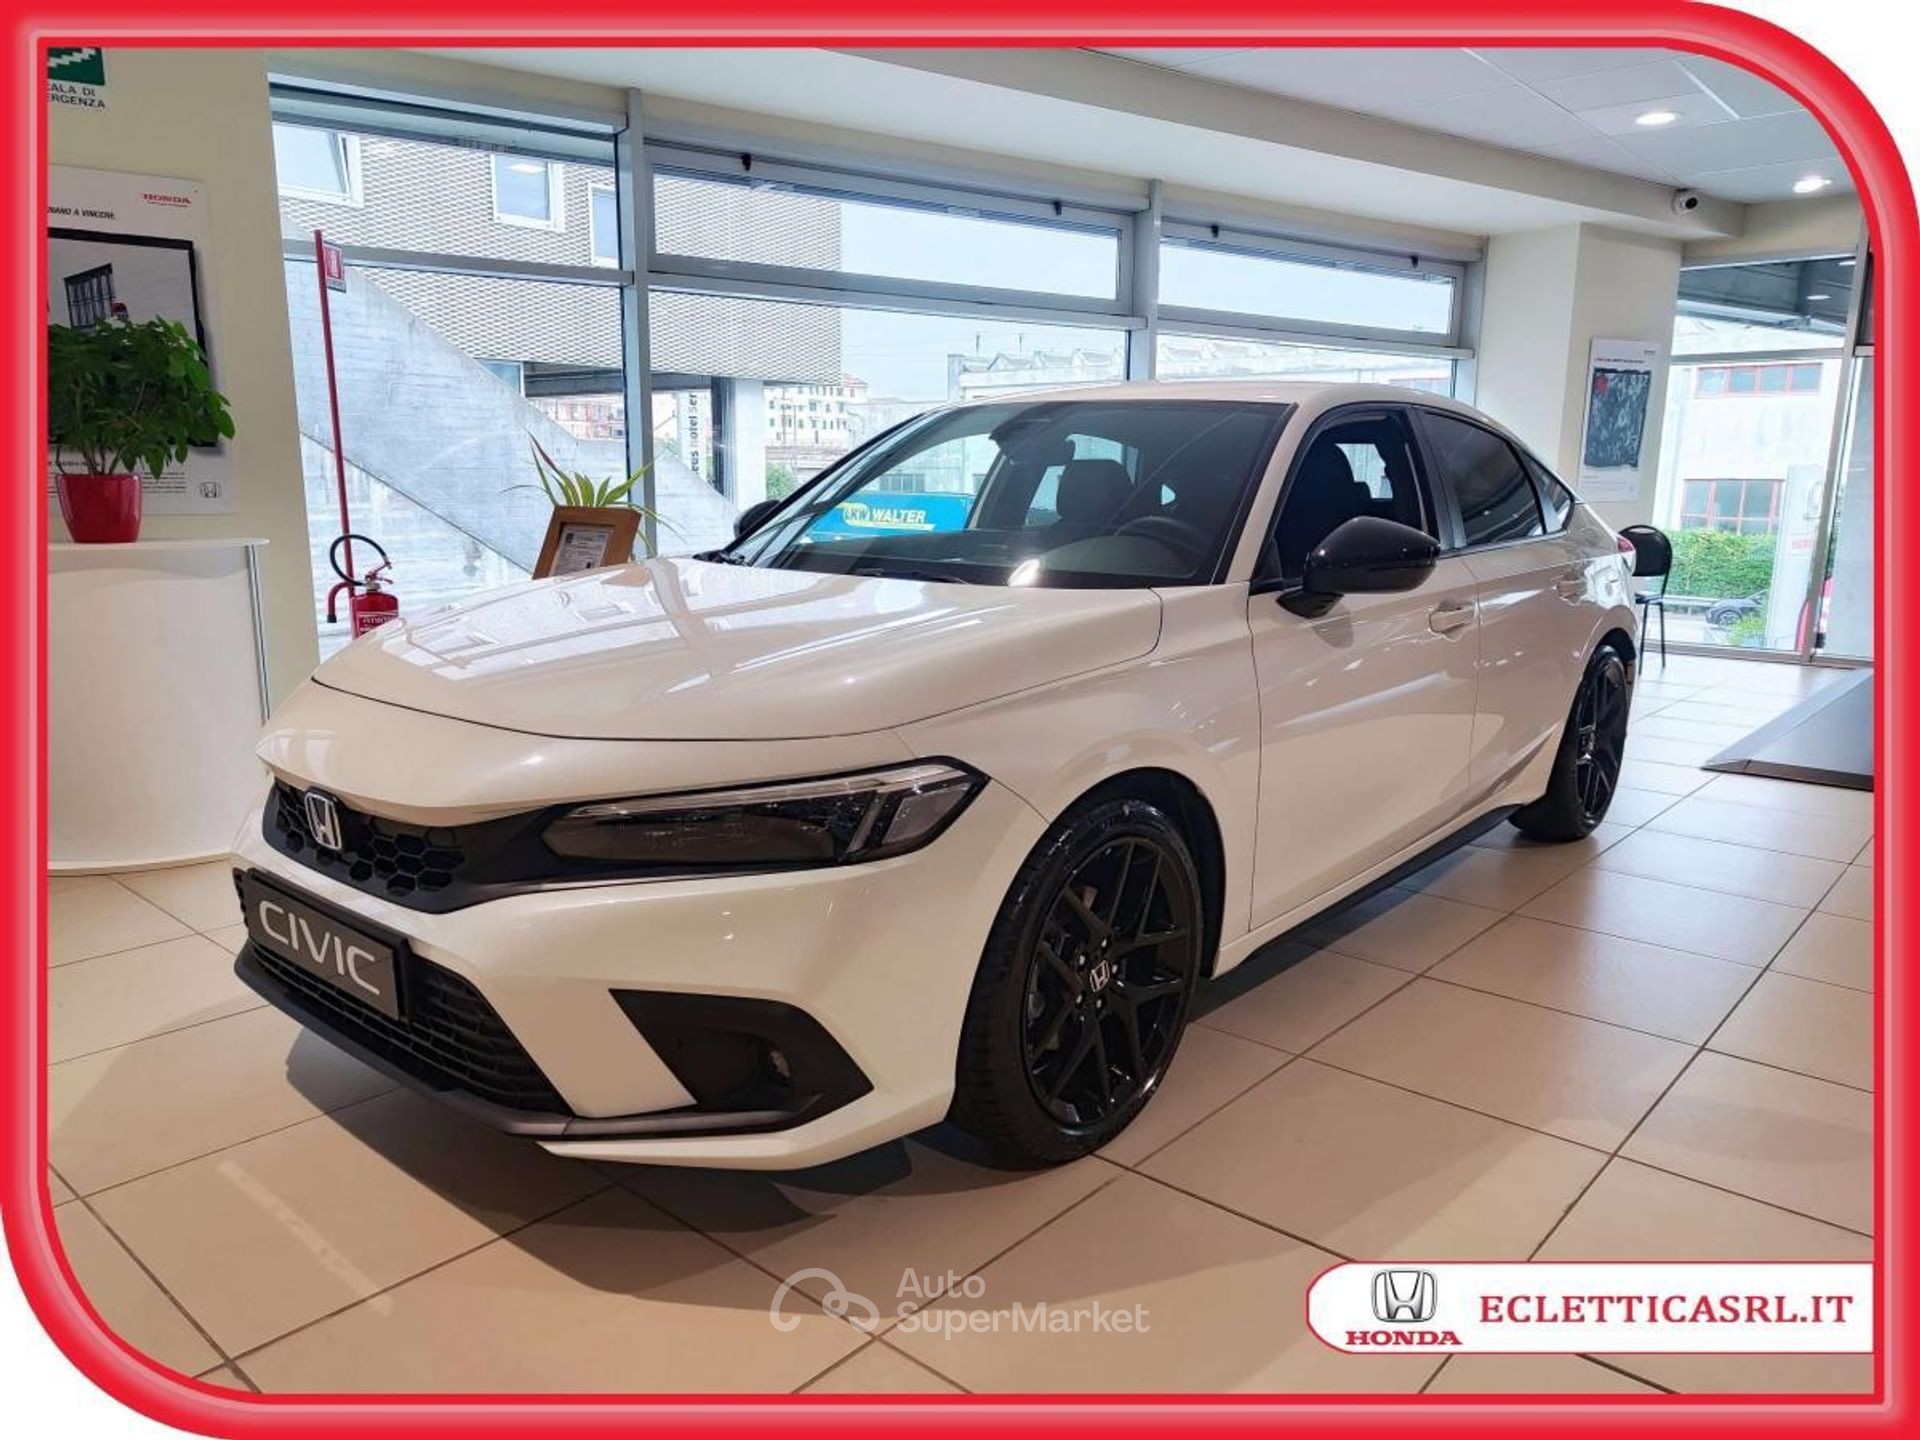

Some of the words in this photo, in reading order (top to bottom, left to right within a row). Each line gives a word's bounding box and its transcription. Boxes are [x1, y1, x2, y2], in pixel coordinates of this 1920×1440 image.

[48, 82, 77, 94] ALA
[82, 87, 96, 97] DI
[143, 193, 191, 204] HONDA
[73, 208, 80, 217] A
[690, 450, 700, 475] eus
[872, 508, 927, 523] WALTER
[259, 900, 381, 996] CIVIC
